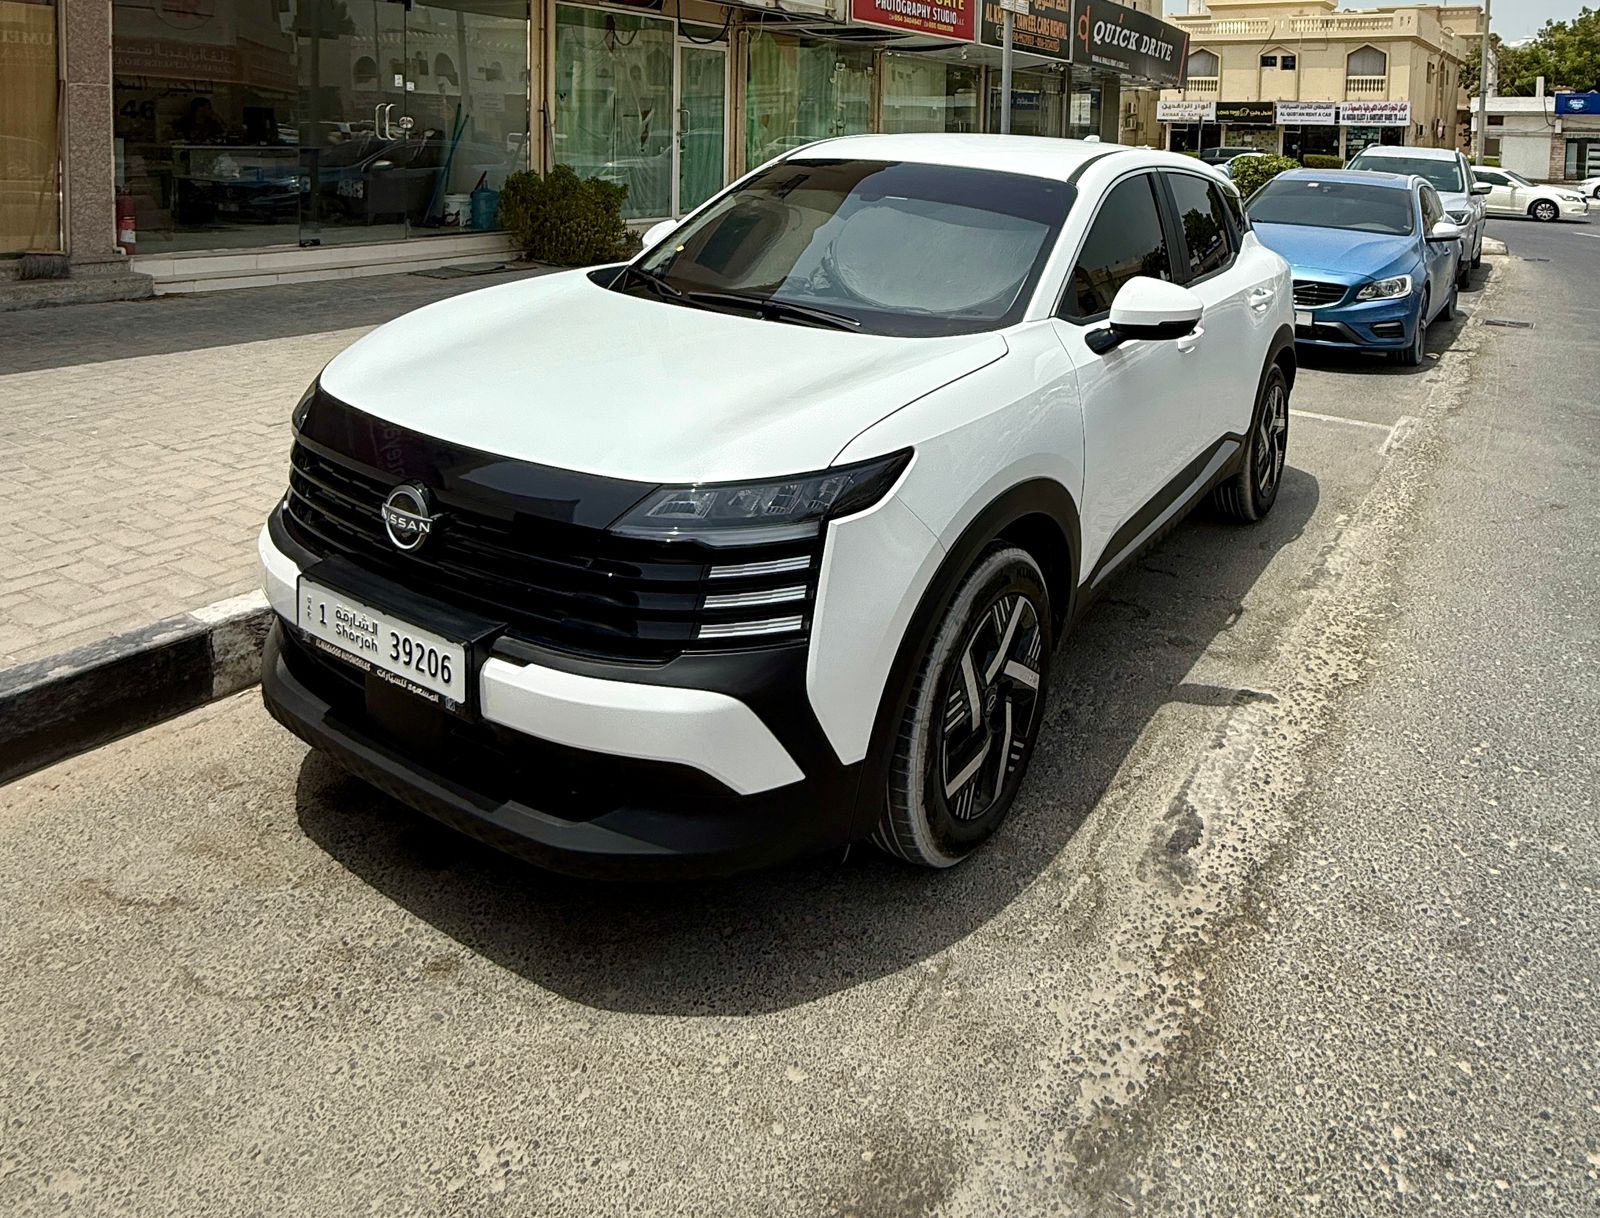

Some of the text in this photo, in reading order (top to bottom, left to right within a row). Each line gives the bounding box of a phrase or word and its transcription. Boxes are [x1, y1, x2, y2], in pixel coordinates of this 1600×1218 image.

[875, 0, 931, 19] PHOTOGRAPHY
[932, 7, 957, 25] STUDIO
[935, 0, 965, 11] GATE
[1037, 16, 1051, 36] CARS
[1050, 19, 1068, 40] RENTAL
[1093, 20, 1140, 51] QUICK
[1140, 35, 1174, 61] DRIVE
[382, 504, 430, 533] NISSAN
[319, 603, 327, 626] 1
[335, 604, 378, 636] الشارقة
[335, 622, 378, 652] Sharjah
[390, 630, 452, 684] 39206
[376, 668, 439, 703] المسعود للسيارات
